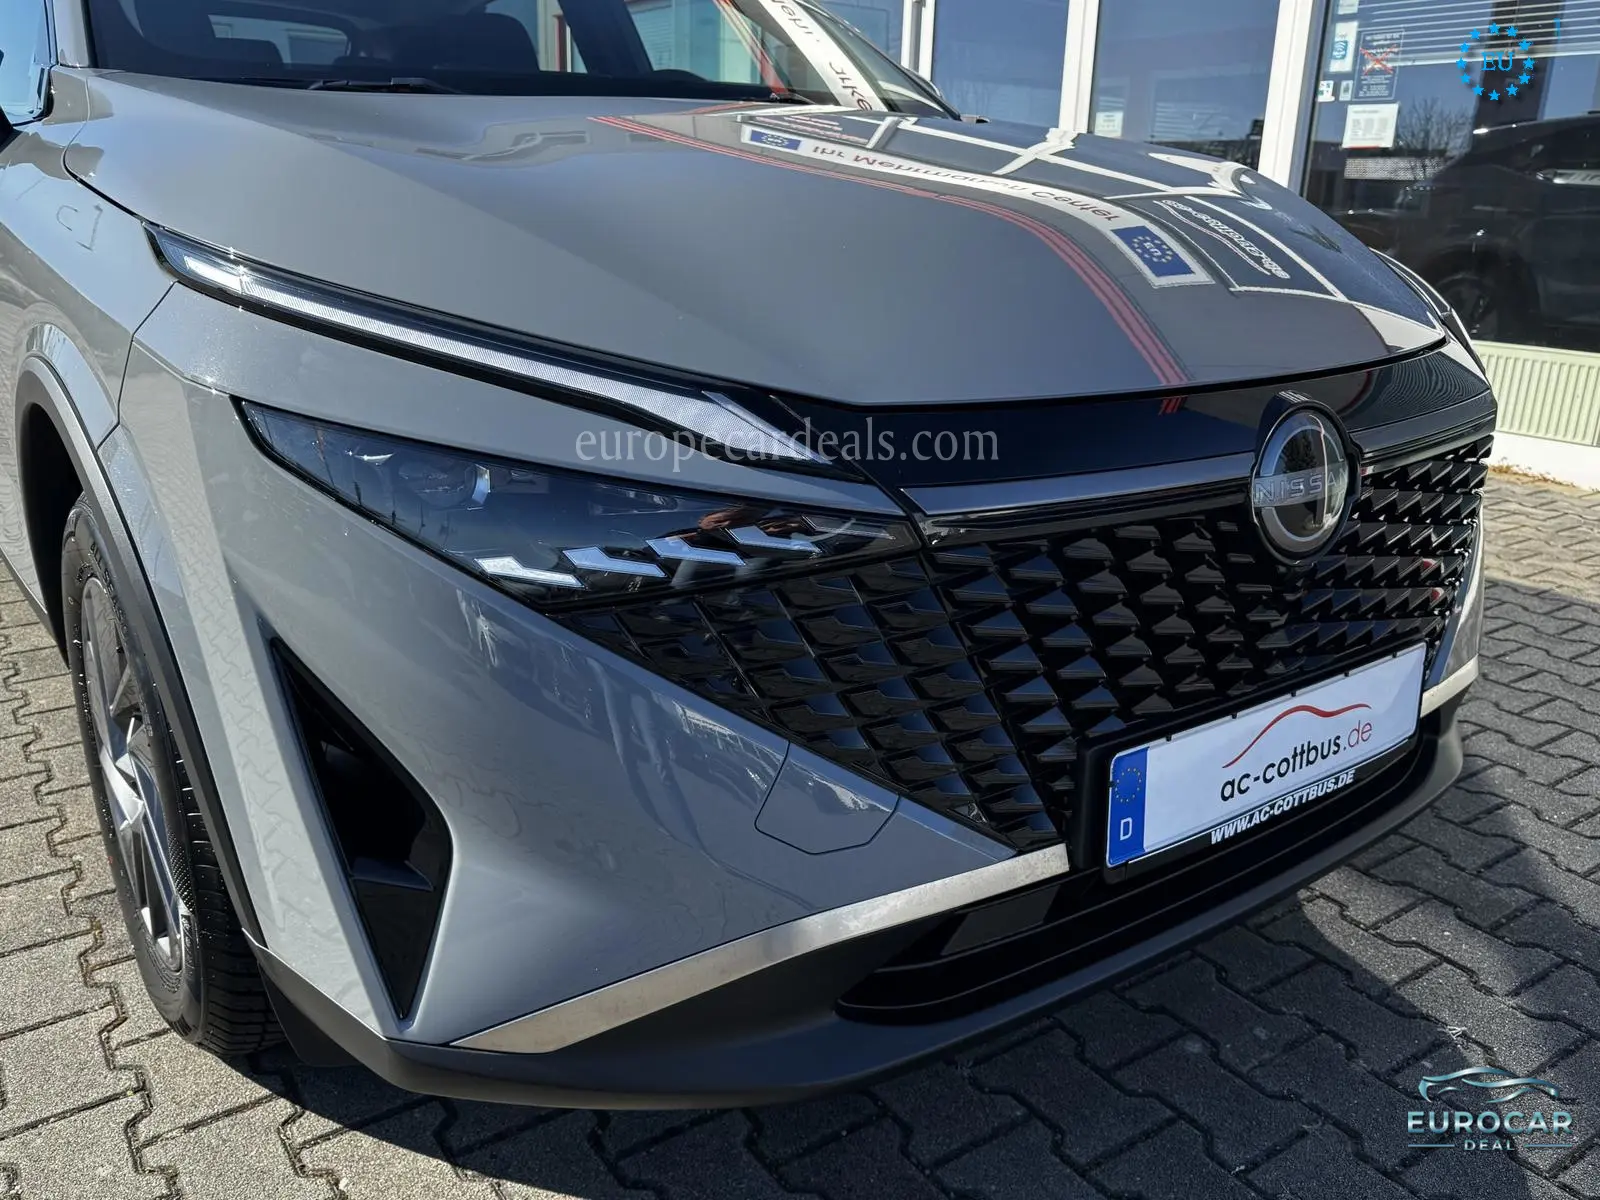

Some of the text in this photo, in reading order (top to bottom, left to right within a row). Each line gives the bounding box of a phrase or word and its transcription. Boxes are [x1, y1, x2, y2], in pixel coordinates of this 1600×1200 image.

[1254, 466, 1348, 502] NISSAN
[1220, 719, 1374, 803] ac-cottbus.de
[1120, 817, 1133, 841] D
[1210, 768, 1357, 846] WWW.AC-COTTBUS.DE
